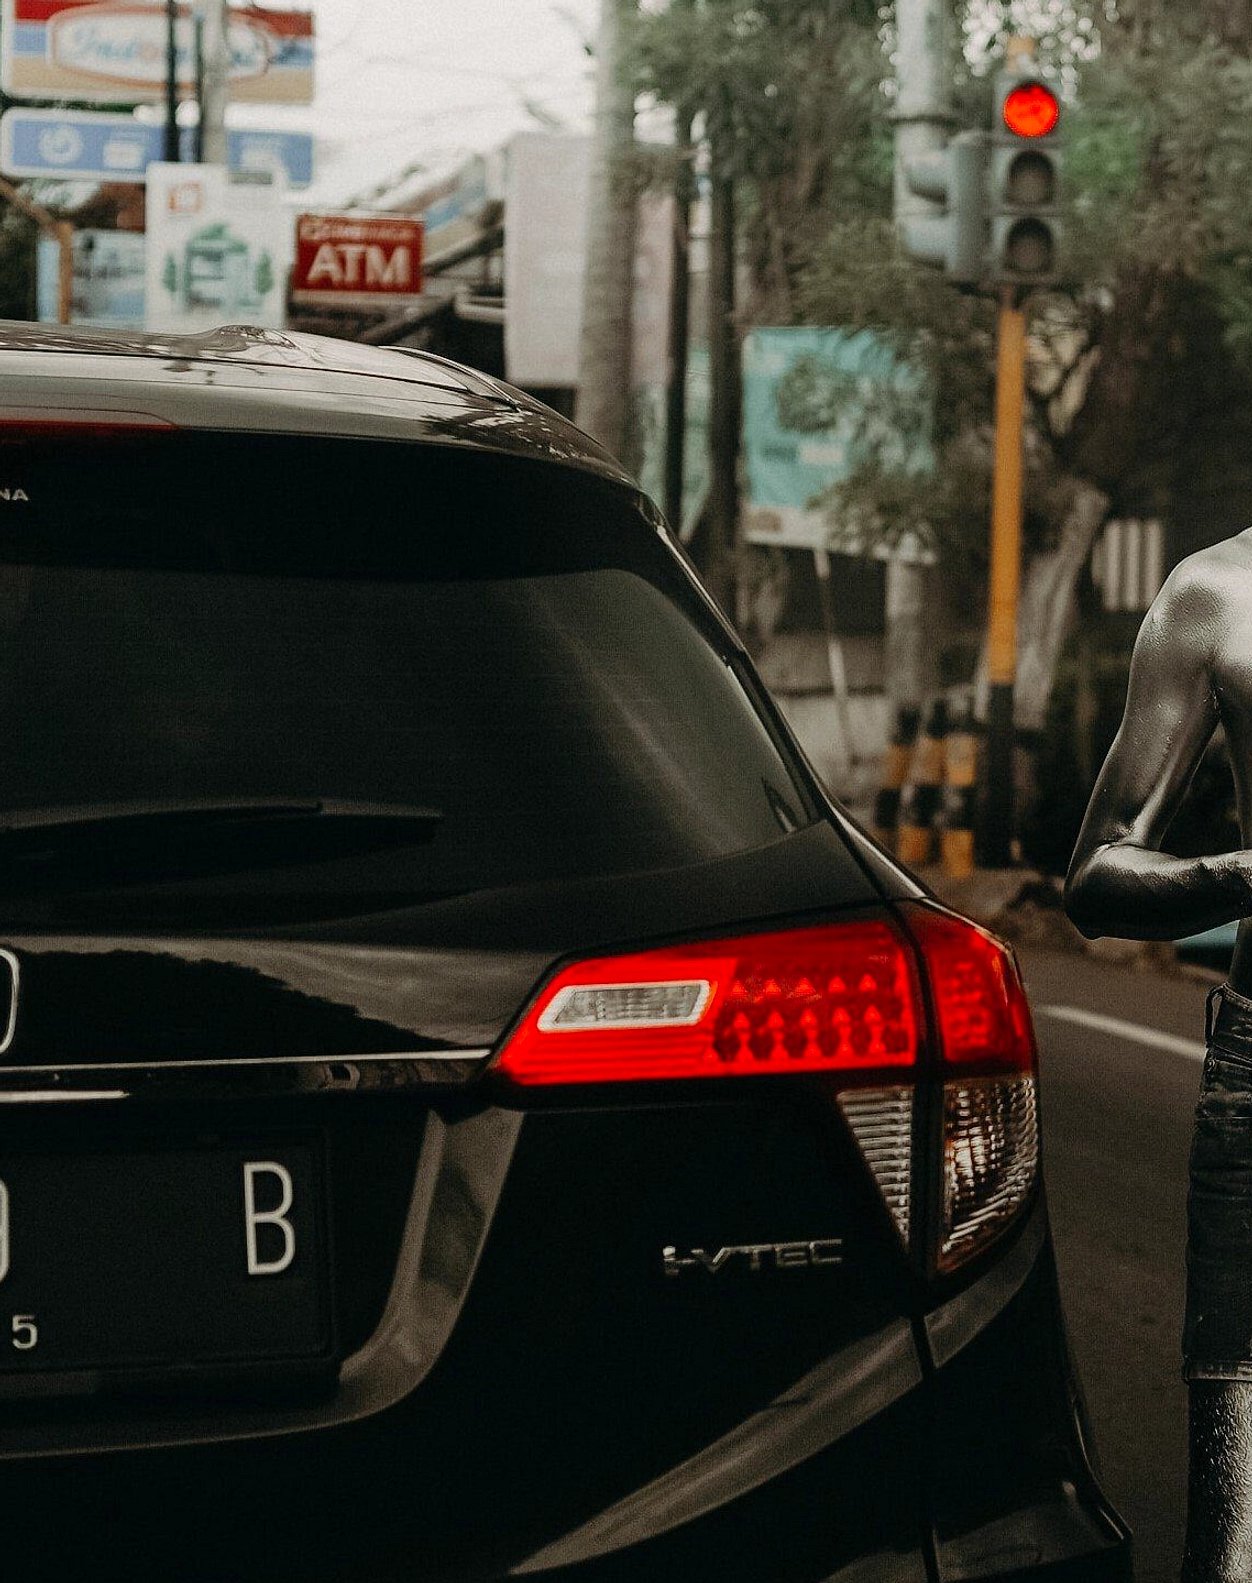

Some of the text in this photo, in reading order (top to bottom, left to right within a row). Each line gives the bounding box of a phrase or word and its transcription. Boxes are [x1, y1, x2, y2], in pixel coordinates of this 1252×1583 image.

[306, 241, 410, 285] ATM
[243, 1160, 296, 1275] B
[12, 1314, 38, 1349] 5
